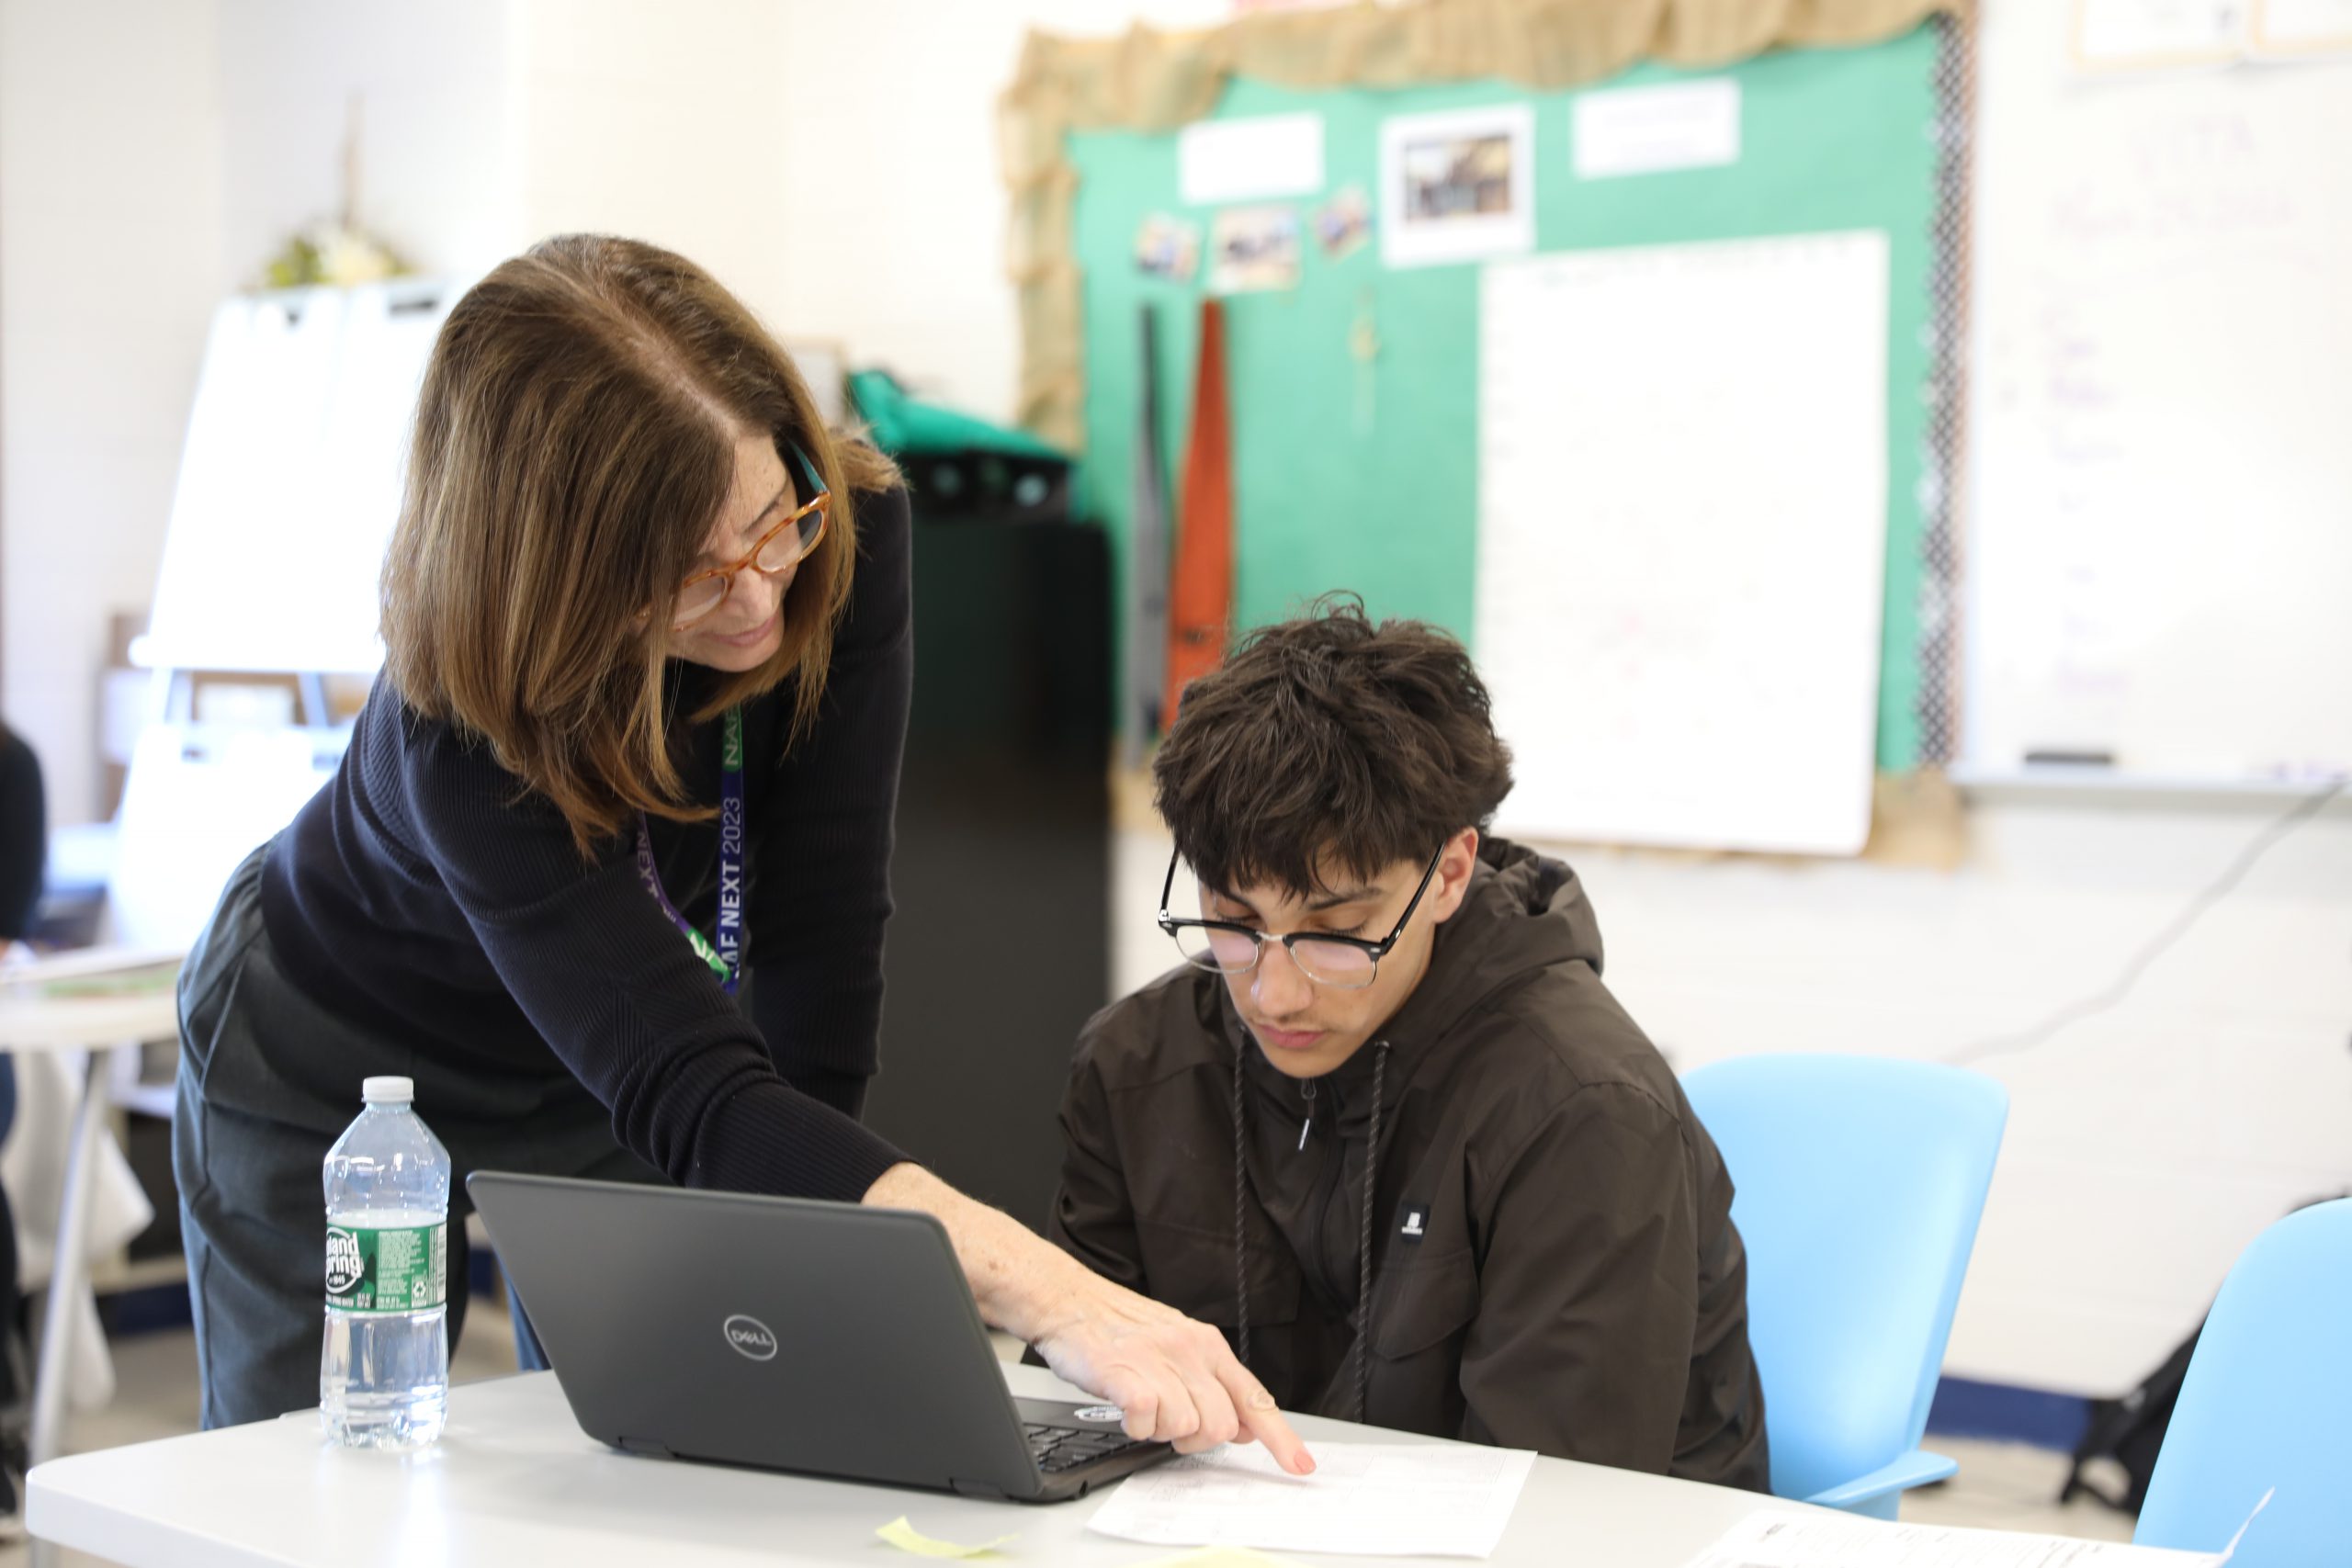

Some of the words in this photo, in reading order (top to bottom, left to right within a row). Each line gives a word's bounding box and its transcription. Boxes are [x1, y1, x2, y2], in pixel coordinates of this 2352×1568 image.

[722, 797, 741, 854] 2023
[720, 859, 741, 928] NEXT
[730, 1329, 772, 1347] DELL
